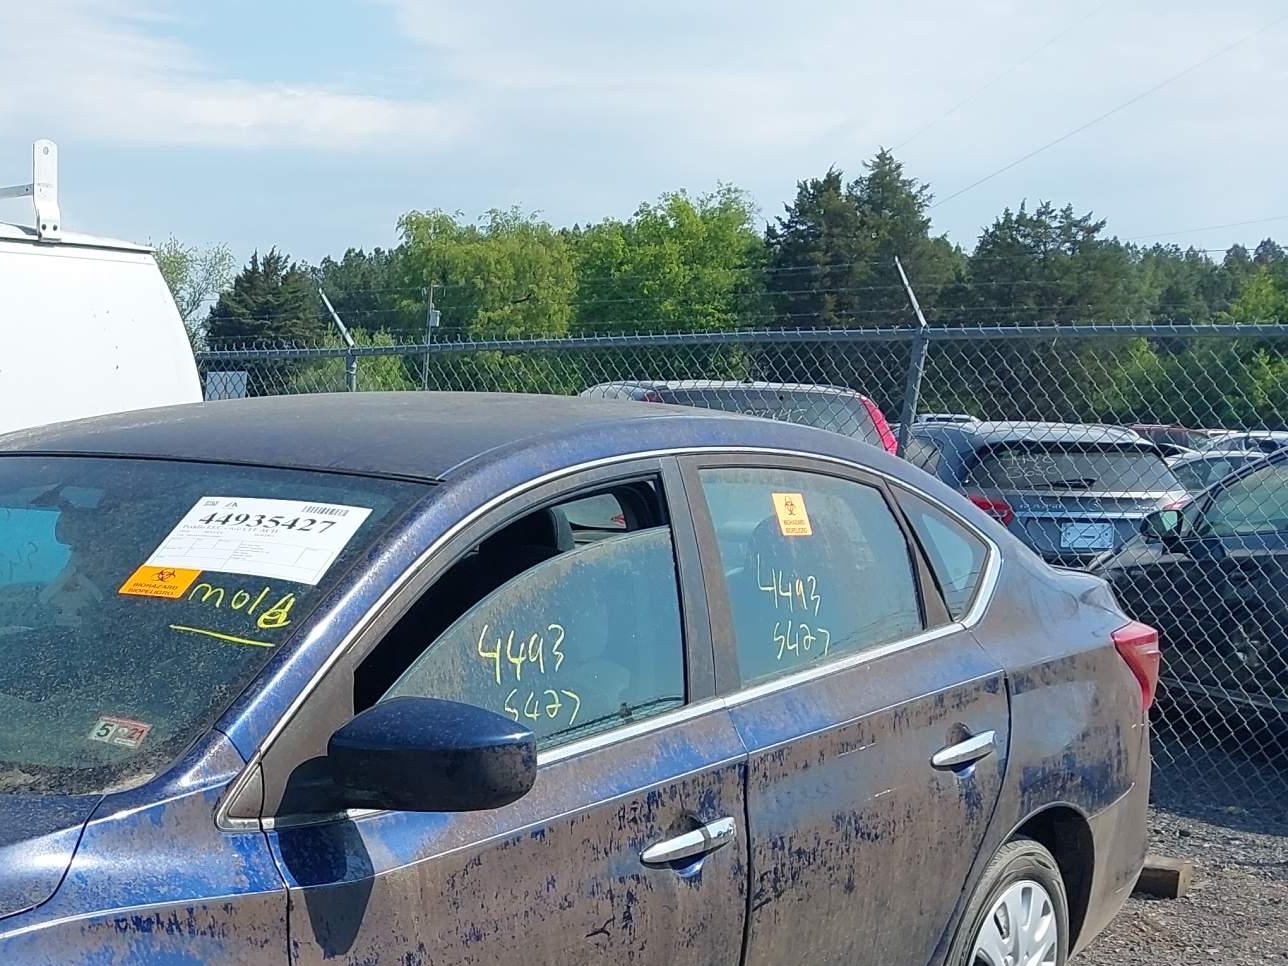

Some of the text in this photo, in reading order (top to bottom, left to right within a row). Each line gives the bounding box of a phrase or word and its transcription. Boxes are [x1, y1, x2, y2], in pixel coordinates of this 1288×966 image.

[199, 511, 337, 534] 44935427
[756, 554, 822, 617] 4493
[477, 623, 566, 686] 4493
[773, 620, 831, 661] 5427
[503, 688, 582, 726] 5427
[96, 723, 115, 738] 5
